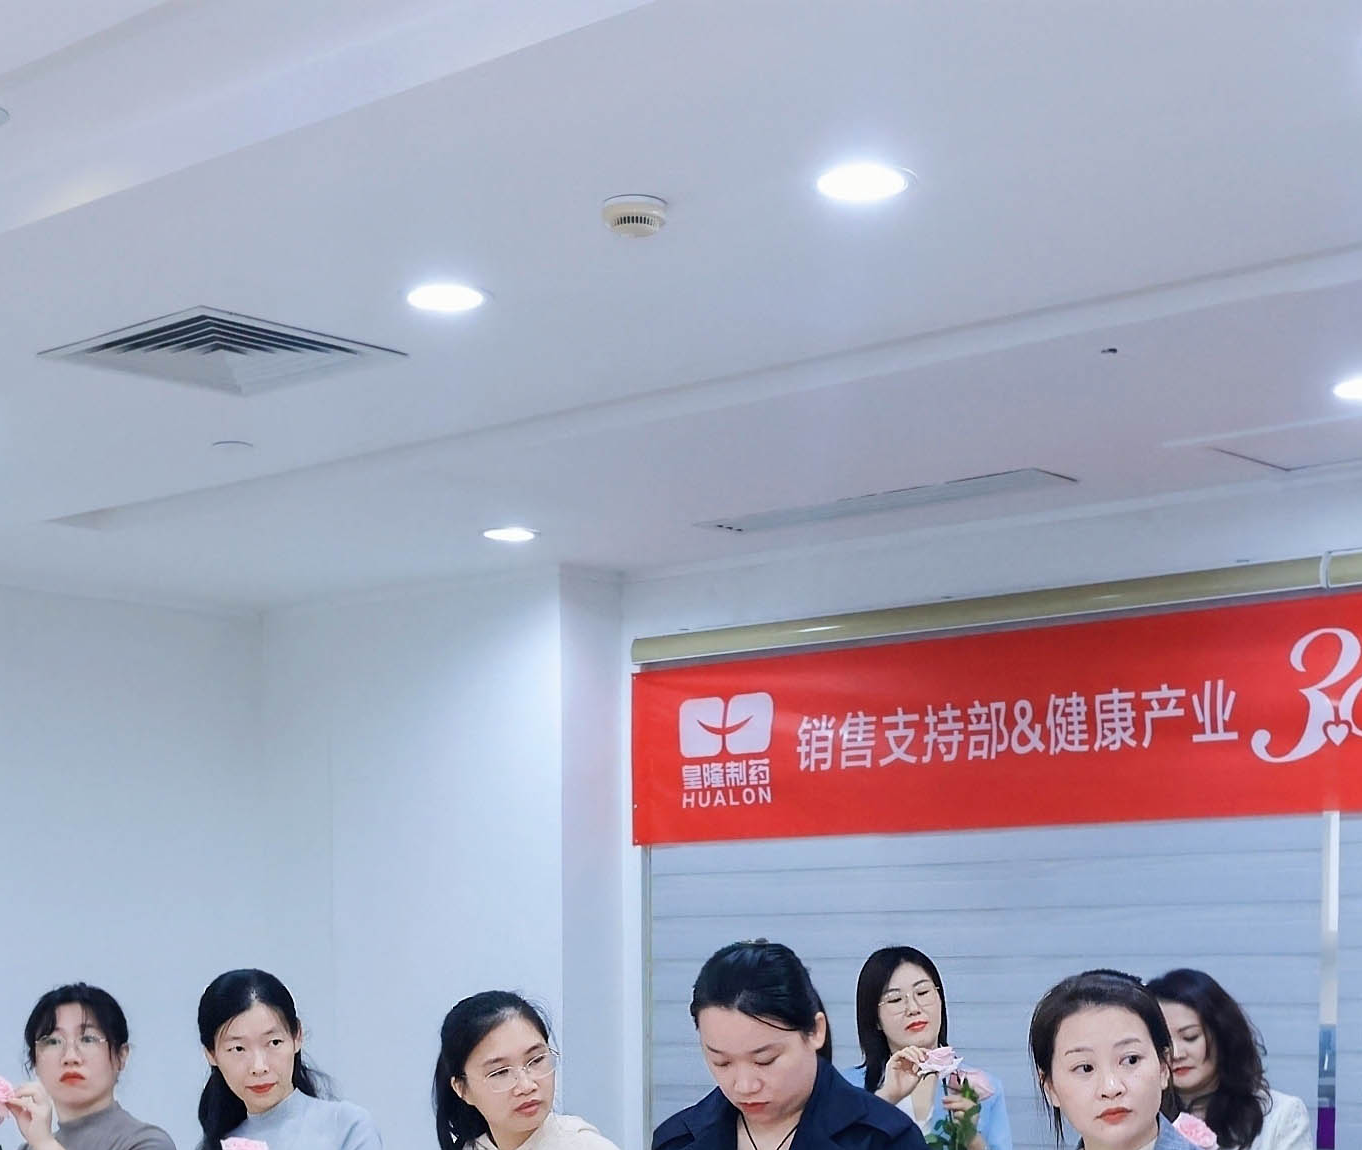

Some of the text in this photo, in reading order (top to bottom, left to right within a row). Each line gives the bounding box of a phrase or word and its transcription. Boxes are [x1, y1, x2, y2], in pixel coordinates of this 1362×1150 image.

[796, 679, 1239, 772] 销售支持部&健康产业
[681, 758, 770, 790] 皇隆制药
[681, 786, 772, 809] HUALON
